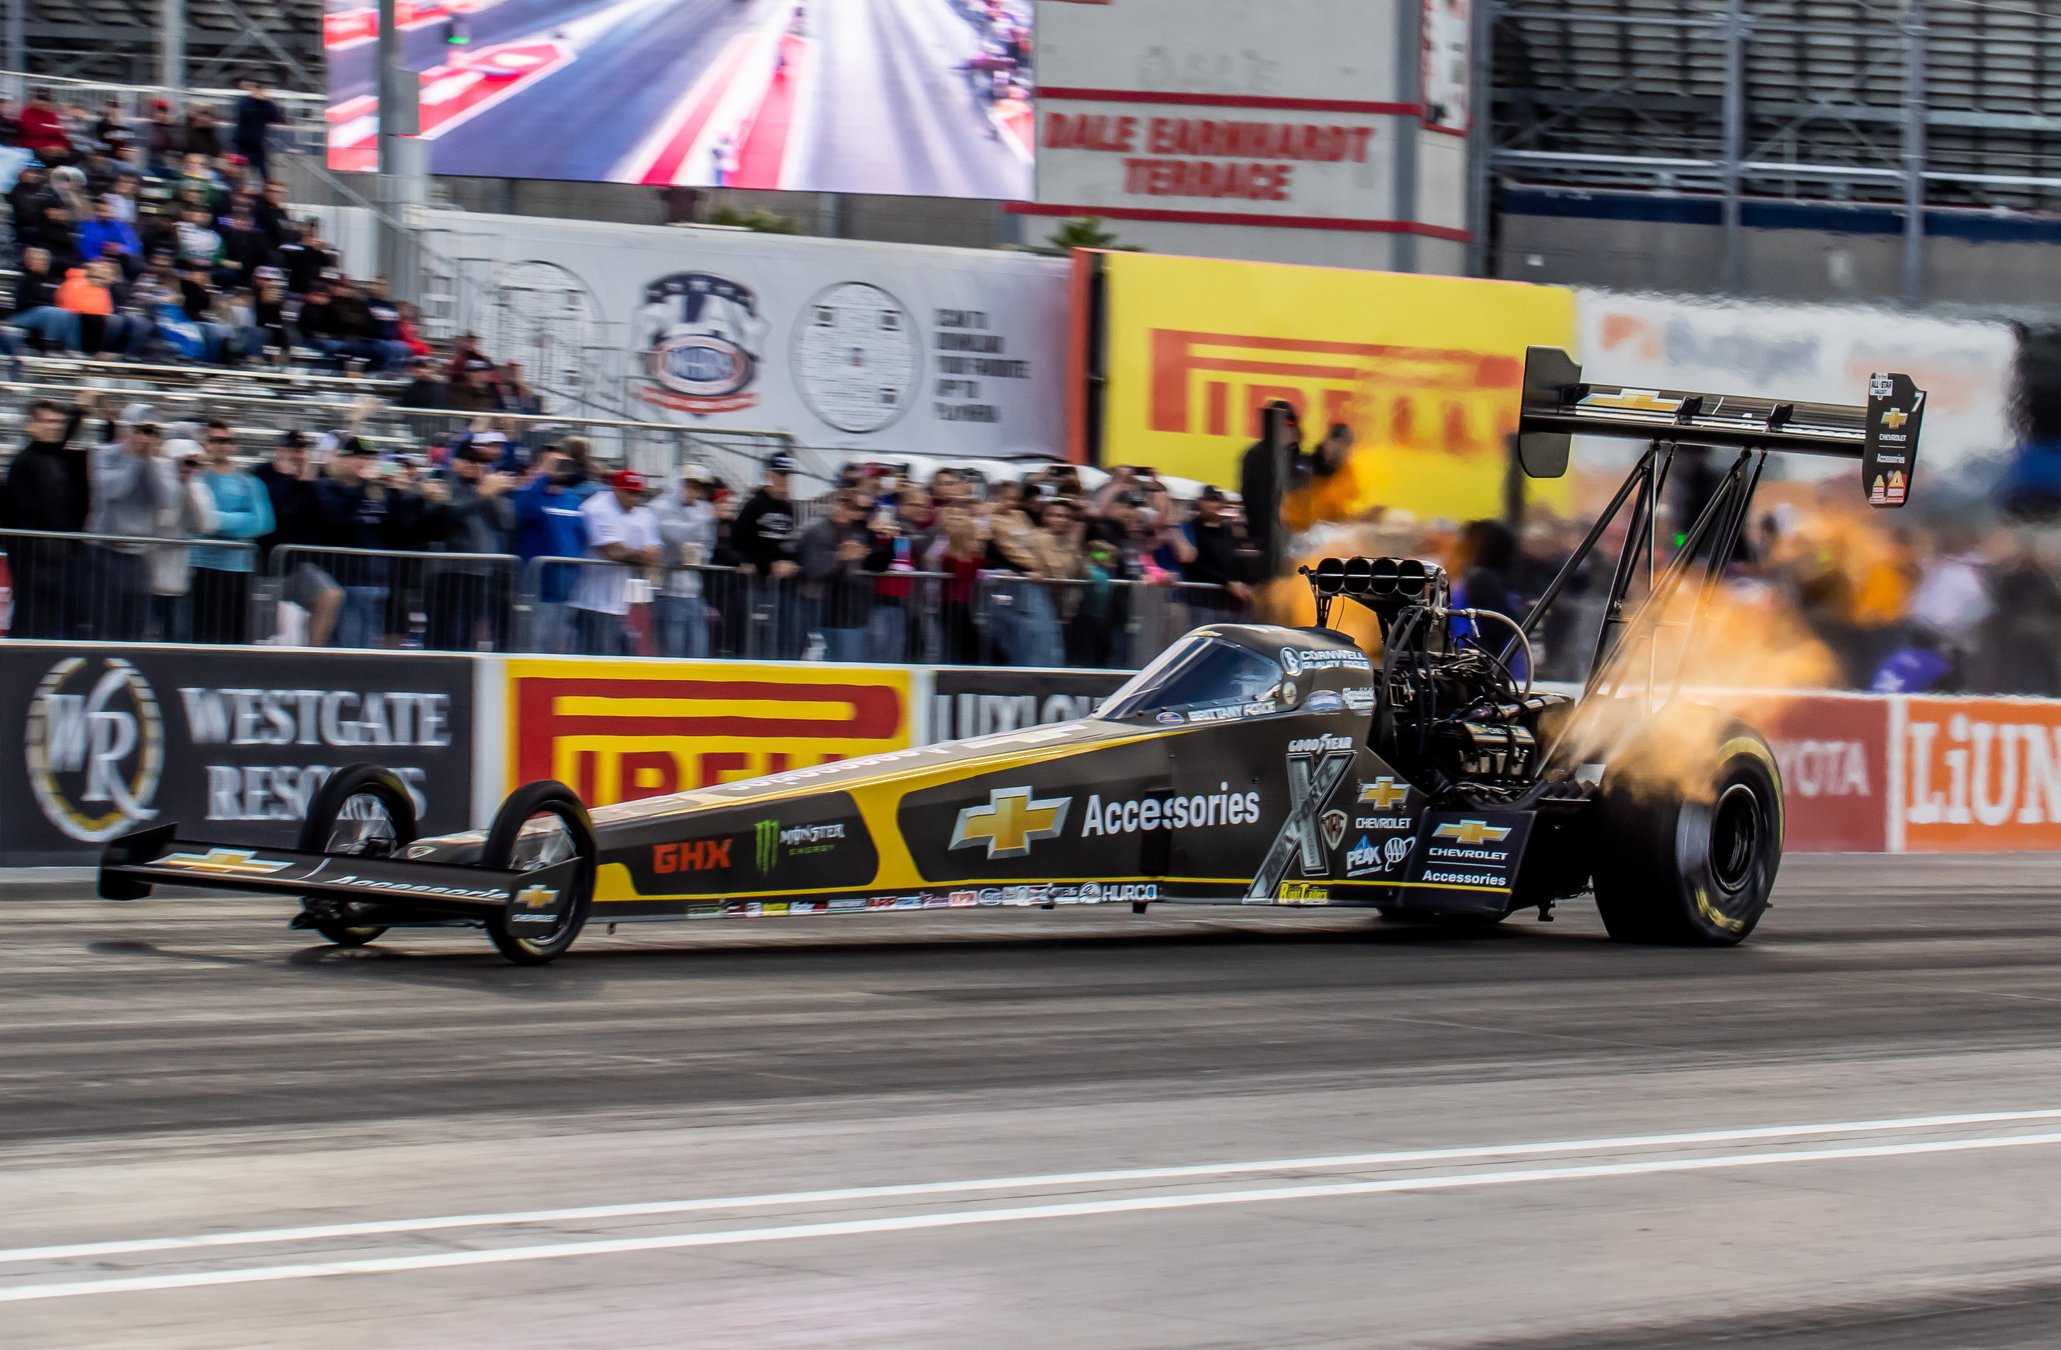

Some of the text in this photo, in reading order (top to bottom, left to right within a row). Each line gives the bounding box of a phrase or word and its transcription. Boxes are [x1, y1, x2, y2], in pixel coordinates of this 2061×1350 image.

[1042, 112, 1379, 163] DALE EARNHARDT
[1122, 157, 1294, 201] TERRACE
[1911, 391, 1924, 412] 7
[1300, 650, 1367, 661] CORNWELL
[177, 687, 453, 746] WESTGATE
[1288, 733, 1353, 755] GOODYEAR
[1766, 739, 1871, 797] YOTA
[1907, 712, 2061, 826] LiUN
[1081, 781, 1260, 838] Accessories
[780, 823, 845, 845] MONSTER
[1355, 817, 1412, 829] CHEVROLET
[653, 838, 733, 874] GHX
[1347, 846, 1382, 871] PEAK
[1429, 847, 1509, 861] CHEVROLET
[1422, 870, 1506, 886] Accessories
